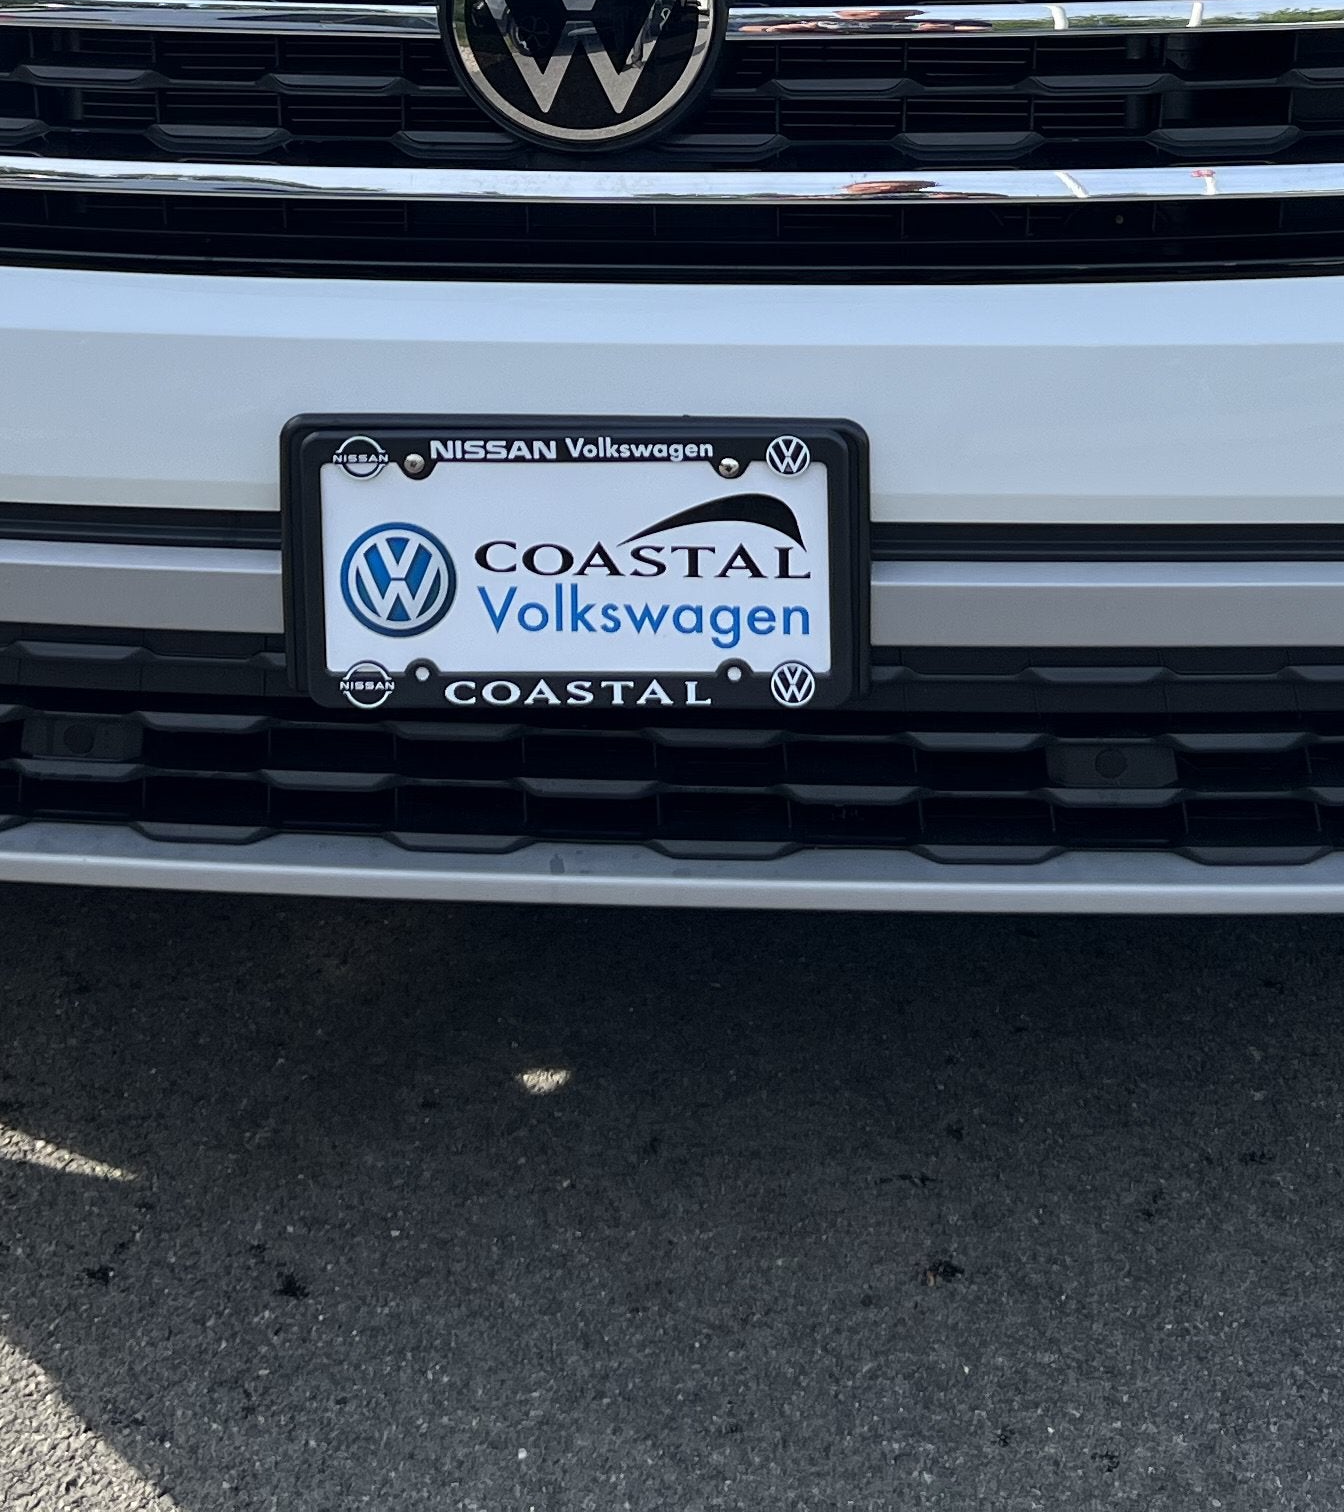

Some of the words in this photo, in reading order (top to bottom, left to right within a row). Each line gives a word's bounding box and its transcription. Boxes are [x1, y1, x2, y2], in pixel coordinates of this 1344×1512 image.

[333, 452, 389, 465] NISSAN
[430, 439, 556, 460] NISSAN
[565, 437, 713, 462] Volkswagen
[474, 540, 811, 579] COASTAL
[477, 583, 811, 648] Volkswagen
[339, 679, 394, 692] NISSAN
[444, 680, 712, 706] COASTAL
